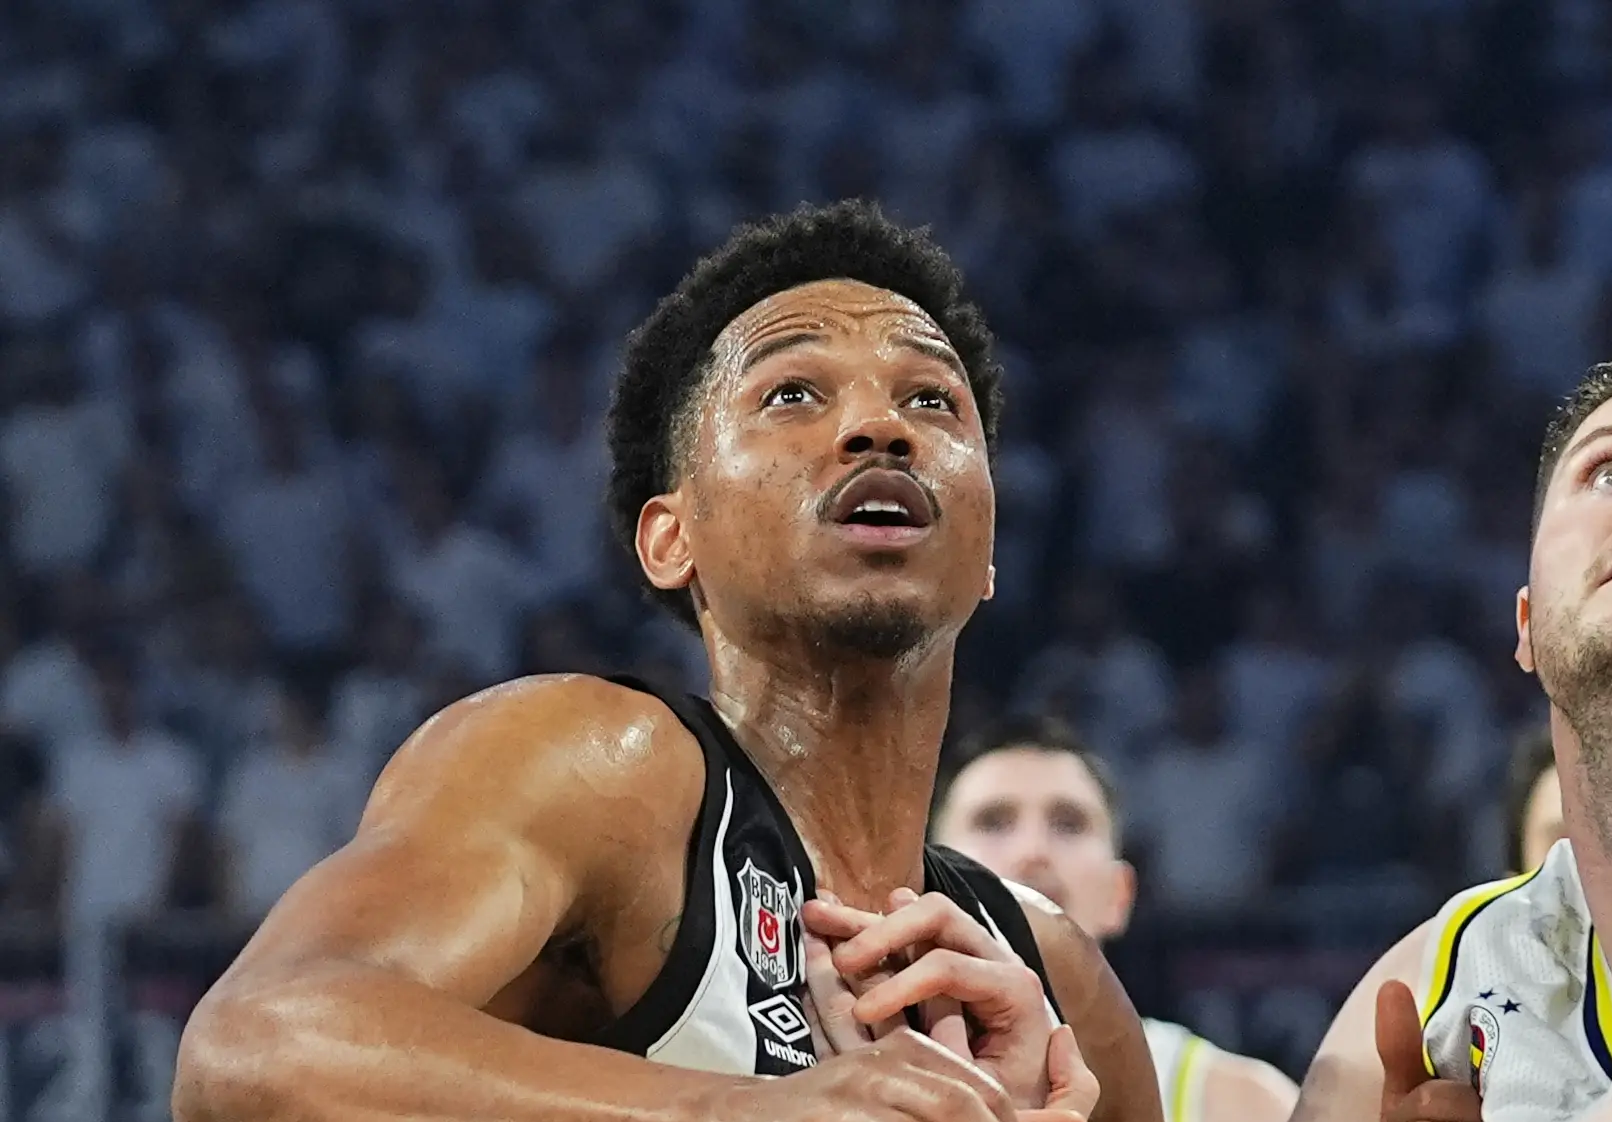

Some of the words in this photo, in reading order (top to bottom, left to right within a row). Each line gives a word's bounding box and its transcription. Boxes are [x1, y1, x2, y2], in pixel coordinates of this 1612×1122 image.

[751, 876, 785, 916] BJK
[755, 950, 786, 982] 1903
[764, 1037, 818, 1069] umbro
